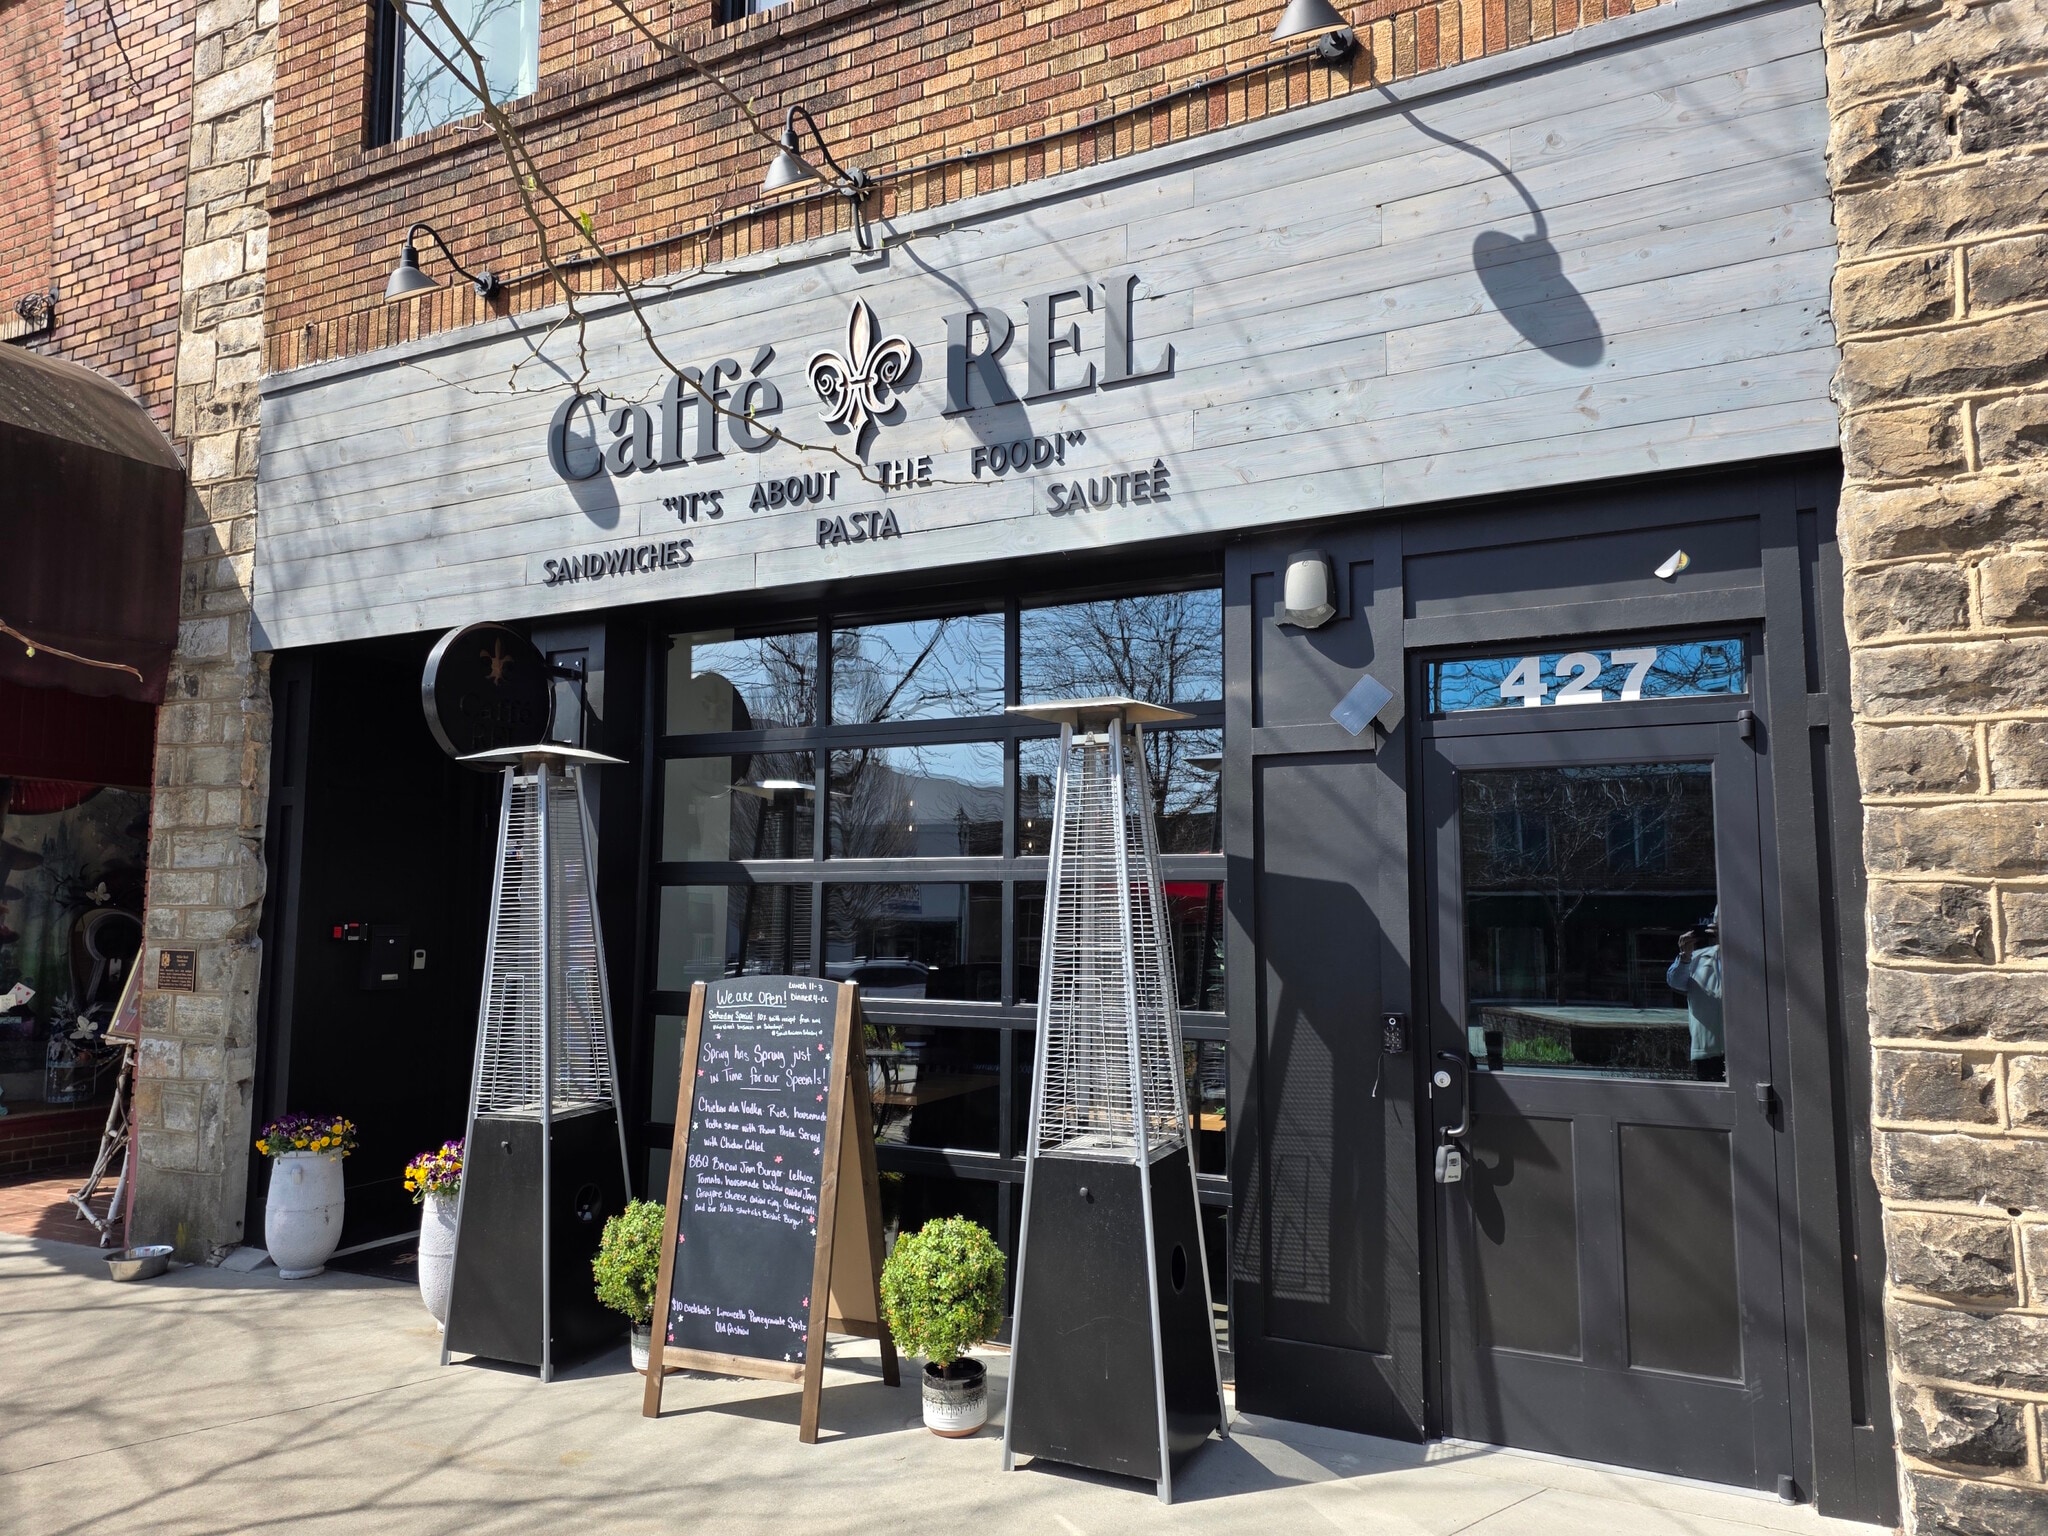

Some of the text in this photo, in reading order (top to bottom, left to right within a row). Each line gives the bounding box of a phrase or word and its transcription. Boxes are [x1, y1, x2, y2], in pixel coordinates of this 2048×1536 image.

[547, 273, 1175, 480] Caffé REL
[749, 469, 840, 512] ABOUT
[875, 454, 933, 490] THE
[542, 538, 694, 586] SANDWICHES
[816, 508, 901, 548] PASTA
[1500, 648, 1657, 707] 427
[716, 989, 734, 1005] We
[703, 1042, 730, 1067] Spring
[754, 1044, 786, 1069] Sprung
[790, 1046, 811, 1068] just
[721, 1067, 743, 1082] Time
[749, 1066, 762, 1085] for
[764, 1074, 780, 1083] our
[698, 1095, 727, 1113] Chicken
[704, 1135, 719, 1147] with
[689, 1154, 709, 1168] BBQ
[671, 1297, 683, 1311] $10
[715, 1321, 727, 1333] Old
